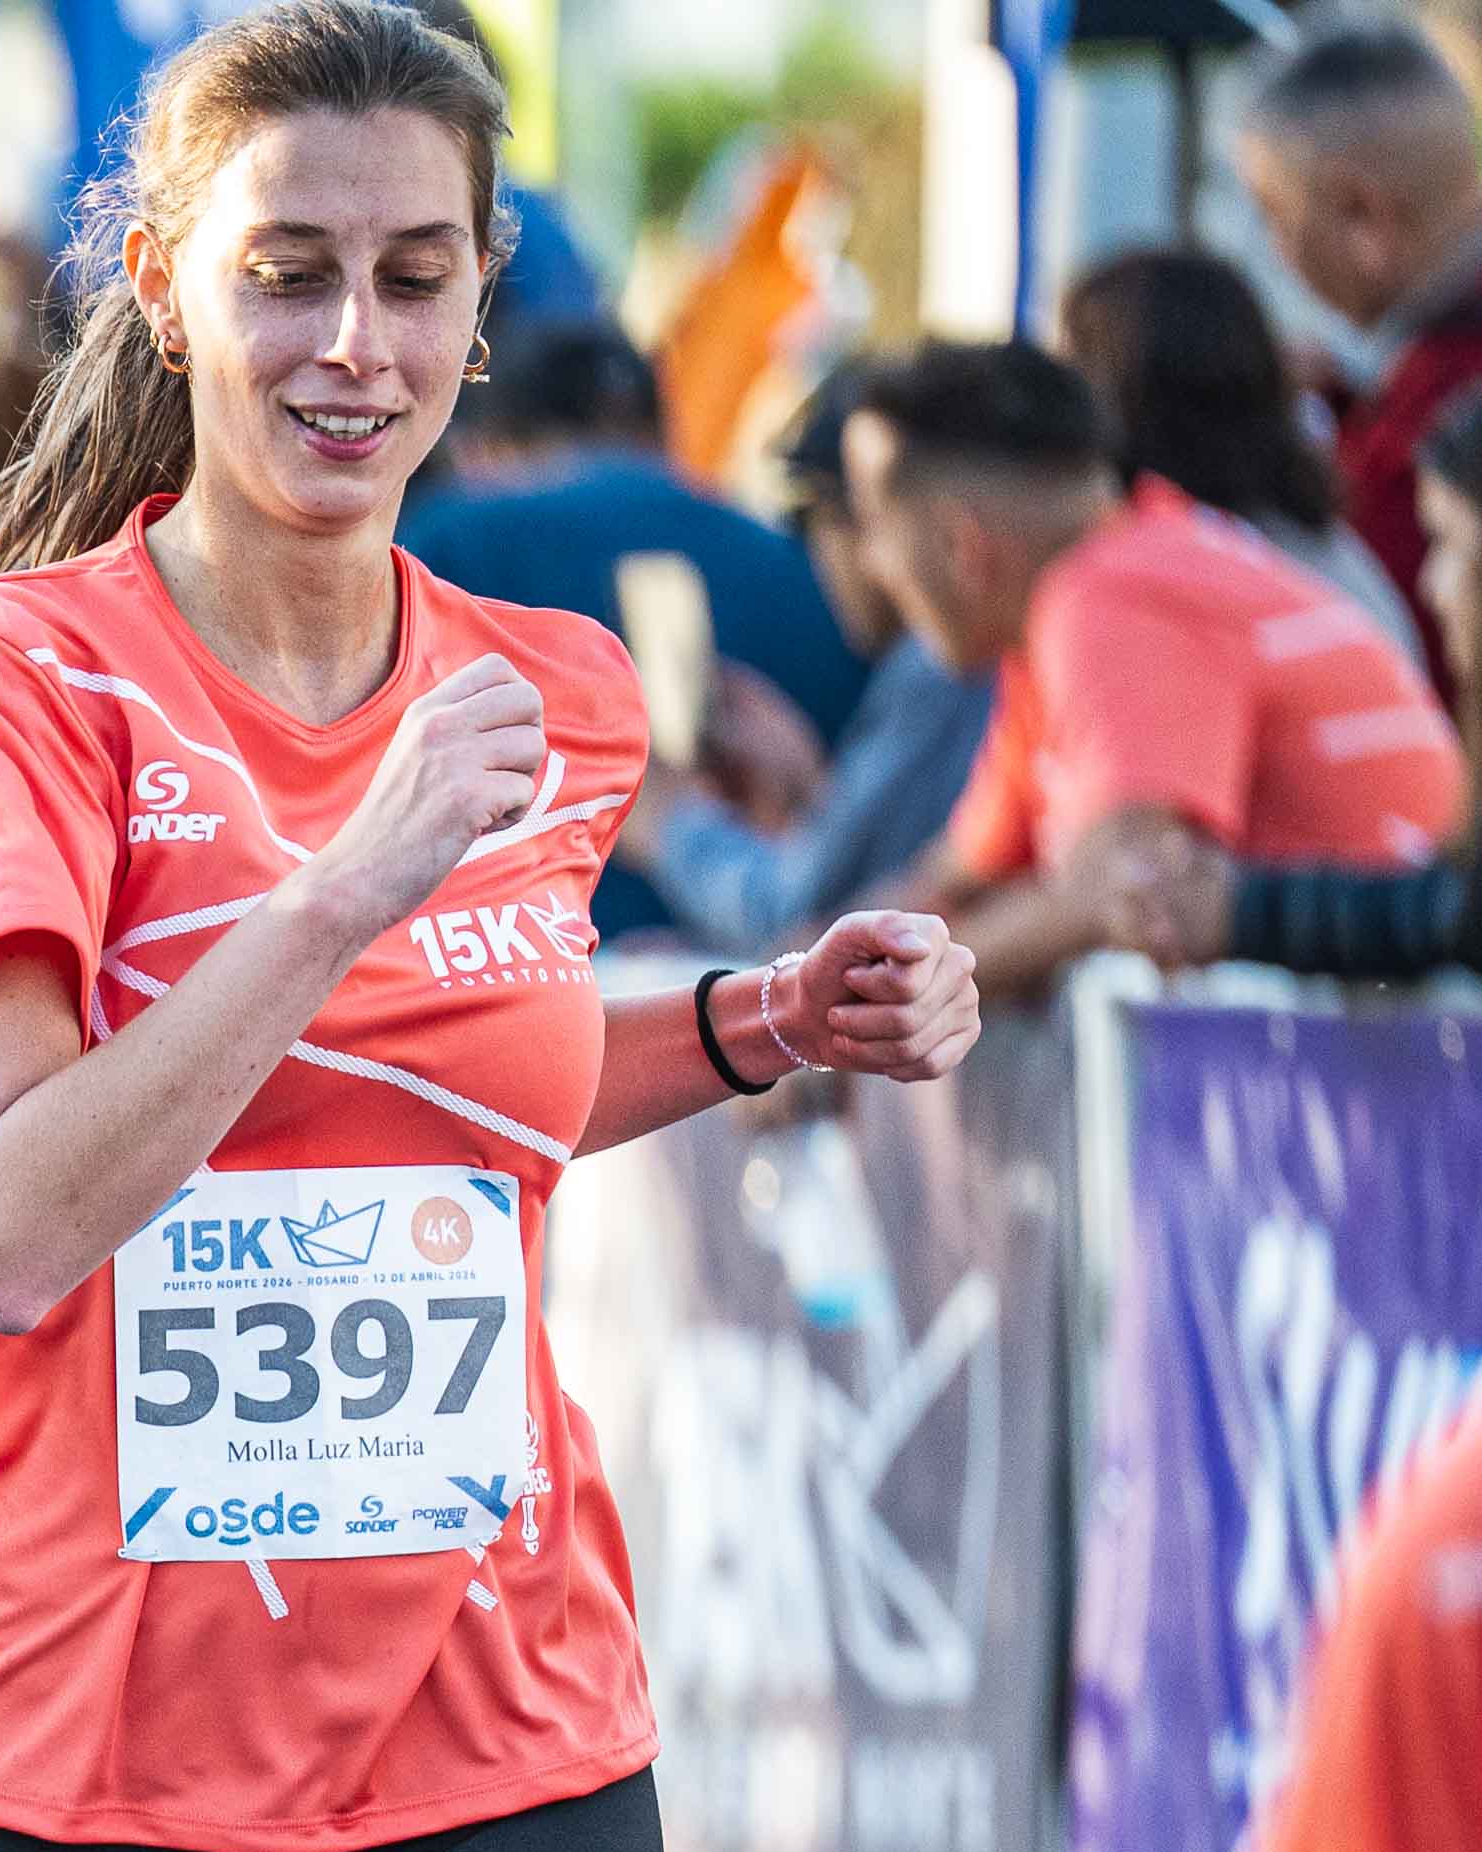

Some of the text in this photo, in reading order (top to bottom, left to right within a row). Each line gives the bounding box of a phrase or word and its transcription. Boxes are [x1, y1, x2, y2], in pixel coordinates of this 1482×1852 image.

[128, 813, 227, 843] ONDer
[409, 903, 543, 978] 15K
[162, 1217, 272, 1273] 15K
[421, 1217, 460, 1246] 4K
[163, 1280, 212, 1291] PUERTO
[217, 1279, 258, 1289] NORTE
[262, 1277, 292, 1288] 2026
[307, 1274, 359, 1286] ROSARIO
[391, 1272, 405, 1282] DE
[411, 1271, 444, 1281] ABRIL
[134, 1295, 507, 1427] 5397
[227, 1434, 425, 1464] Molla Luz Maria
[185, 1491, 320, 1545] osde
[412, 1506, 469, 1520] POWER
[434, 1518, 465, 1530] ADE
